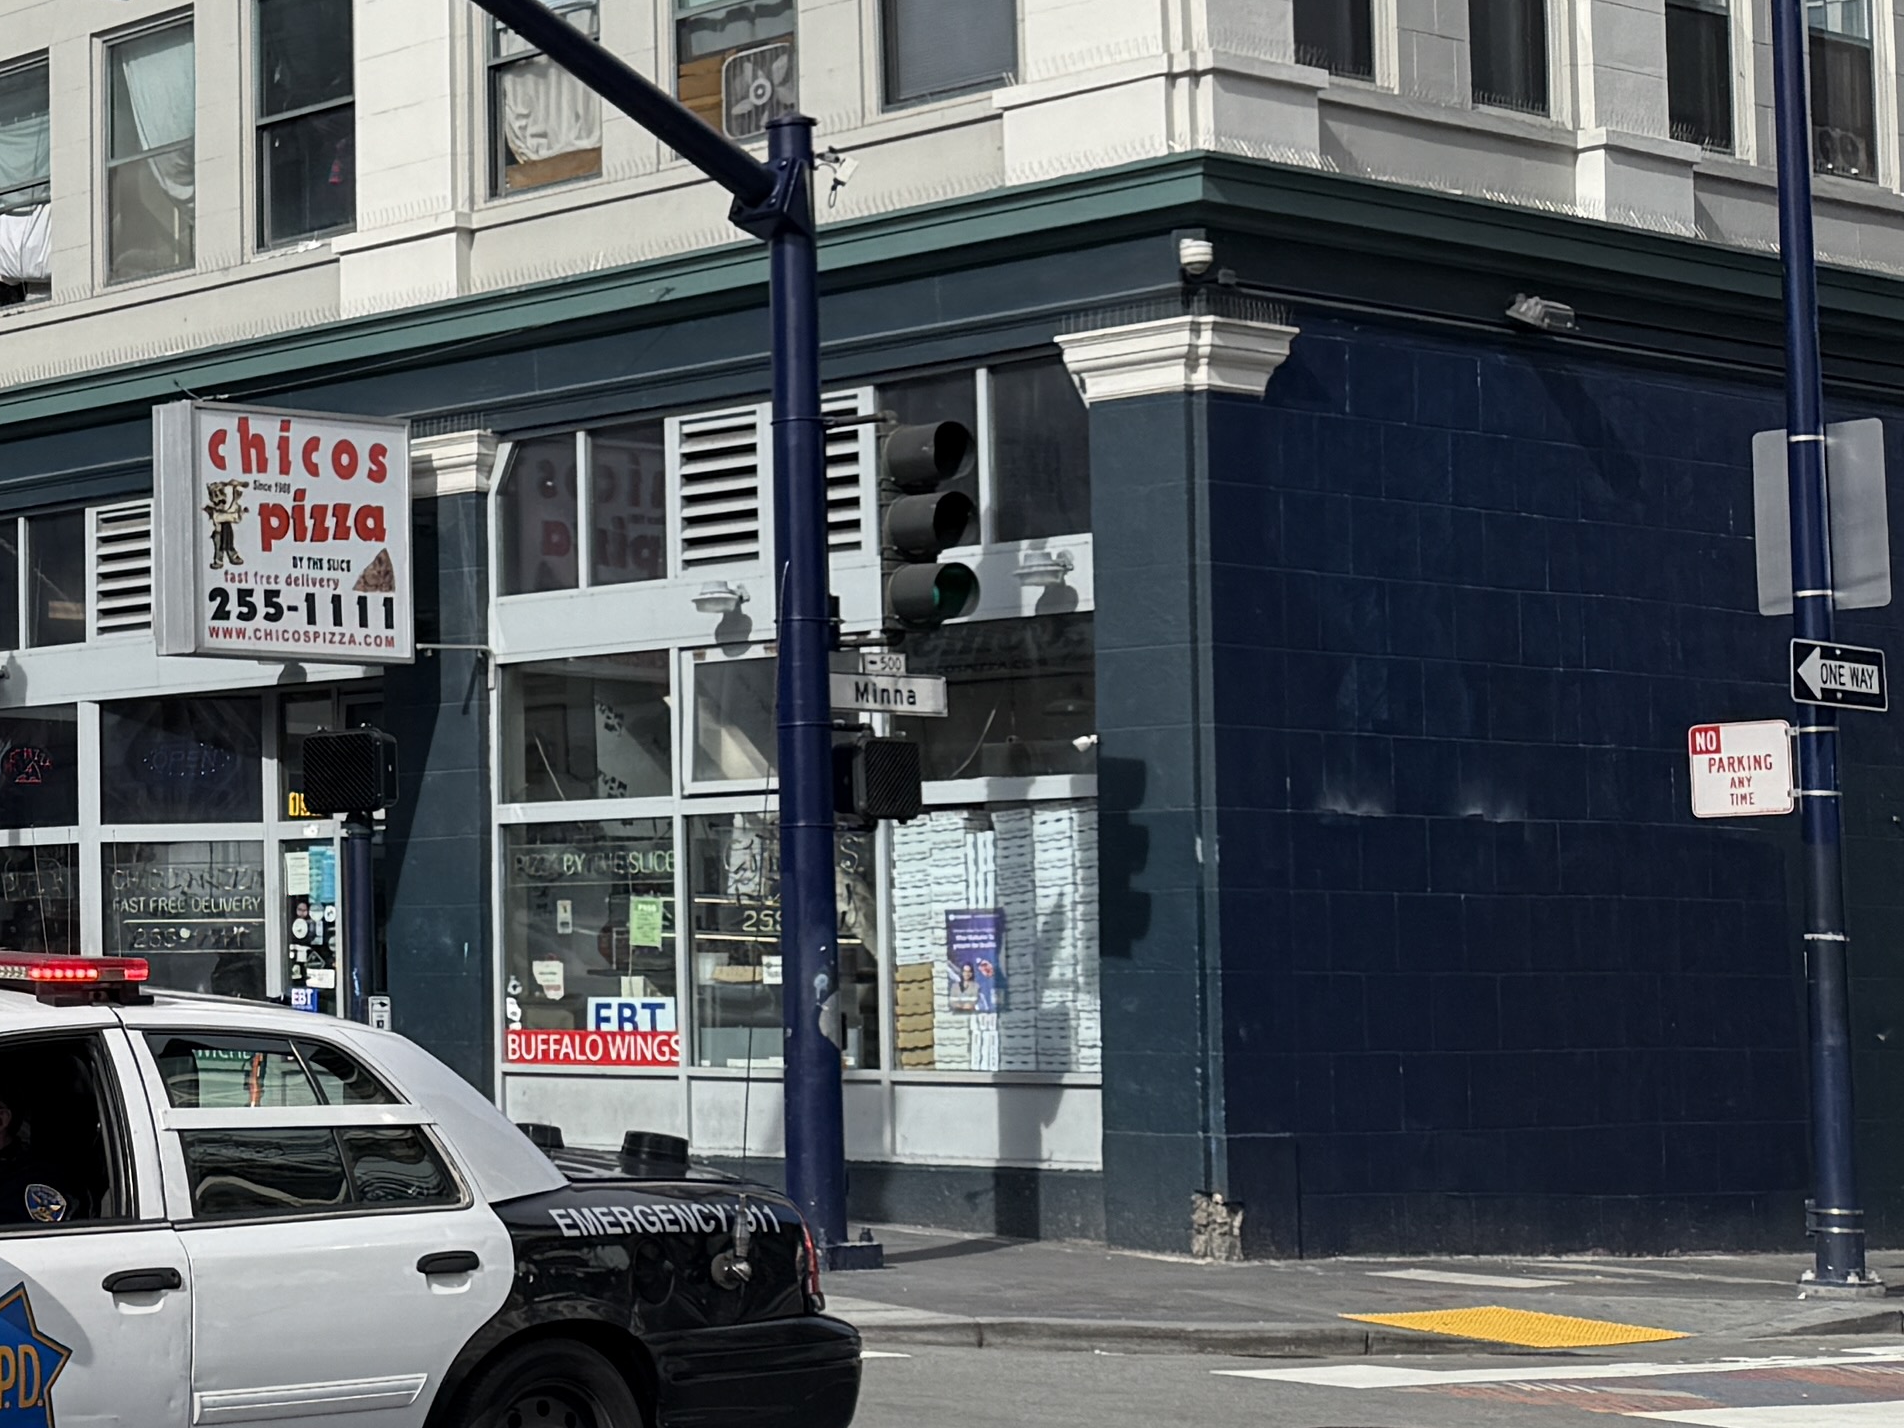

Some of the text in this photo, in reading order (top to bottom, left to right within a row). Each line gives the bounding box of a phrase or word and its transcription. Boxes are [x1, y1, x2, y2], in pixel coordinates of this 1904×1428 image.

[207, 416, 388, 484] chicos
[252, 479, 273, 492] Since
[258, 488, 387, 552] pizza
[292, 556, 351, 572] BY THE SLICE
[224, 570, 340, 590] fast free delivery
[208, 586, 395, 630] 255-1111
[208, 625, 395, 648] WWW.CHICOSPIZZA.COM
[1820, 662, 1875, 690] ONE WAY
[854, 681, 917, 706] Minna
[1695, 731, 1717, 752] NO
[1708, 753, 1773, 773] PARKING
[1730, 776, 1753, 790] ANY
[1730, 793, 1755, 806] TIME
[112, 896, 262, 913] FAST FREE DELIVERY
[291, 988, 314, 1005] EBT
[595, 1002, 666, 1031] EBT
[507, 1034, 680, 1062] BUFFALO WINGS
[549, 1203, 728, 1237] EMERGENCY
